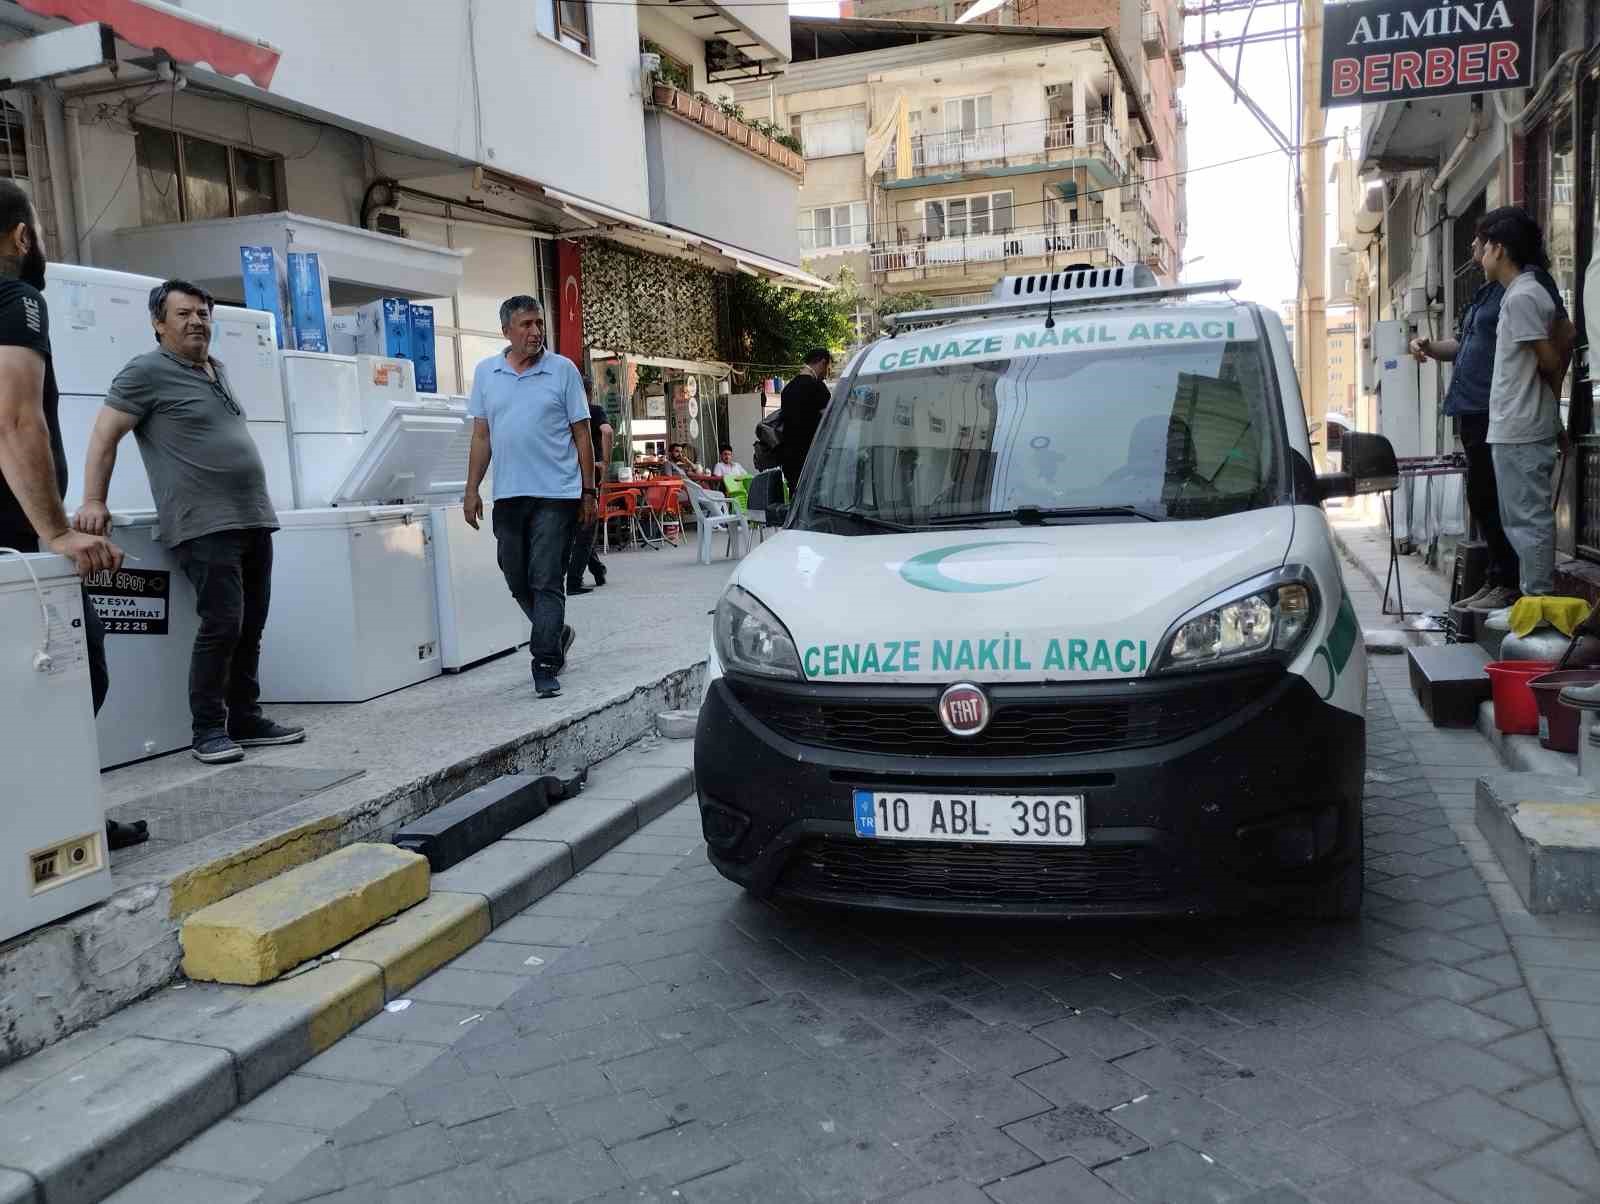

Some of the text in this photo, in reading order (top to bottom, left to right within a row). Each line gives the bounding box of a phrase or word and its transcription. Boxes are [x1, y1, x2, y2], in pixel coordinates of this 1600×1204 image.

[1346, 0, 1514, 45] ALMİNA
[1331, 40, 1520, 97] BERBER
[22, 297, 41, 333] NIKE
[879, 320, 1235, 371] CENAZE NAKİL ARACI
[116, 572, 146, 592] SPOT
[115, 622, 130, 631] 22
[804, 632, 1147, 678] CENAZE NAKİL ARACI
[949, 698, 978, 723] FIAT
[859, 816, 874, 828] TR
[878, 798, 1073, 837] 10 ABL 396
